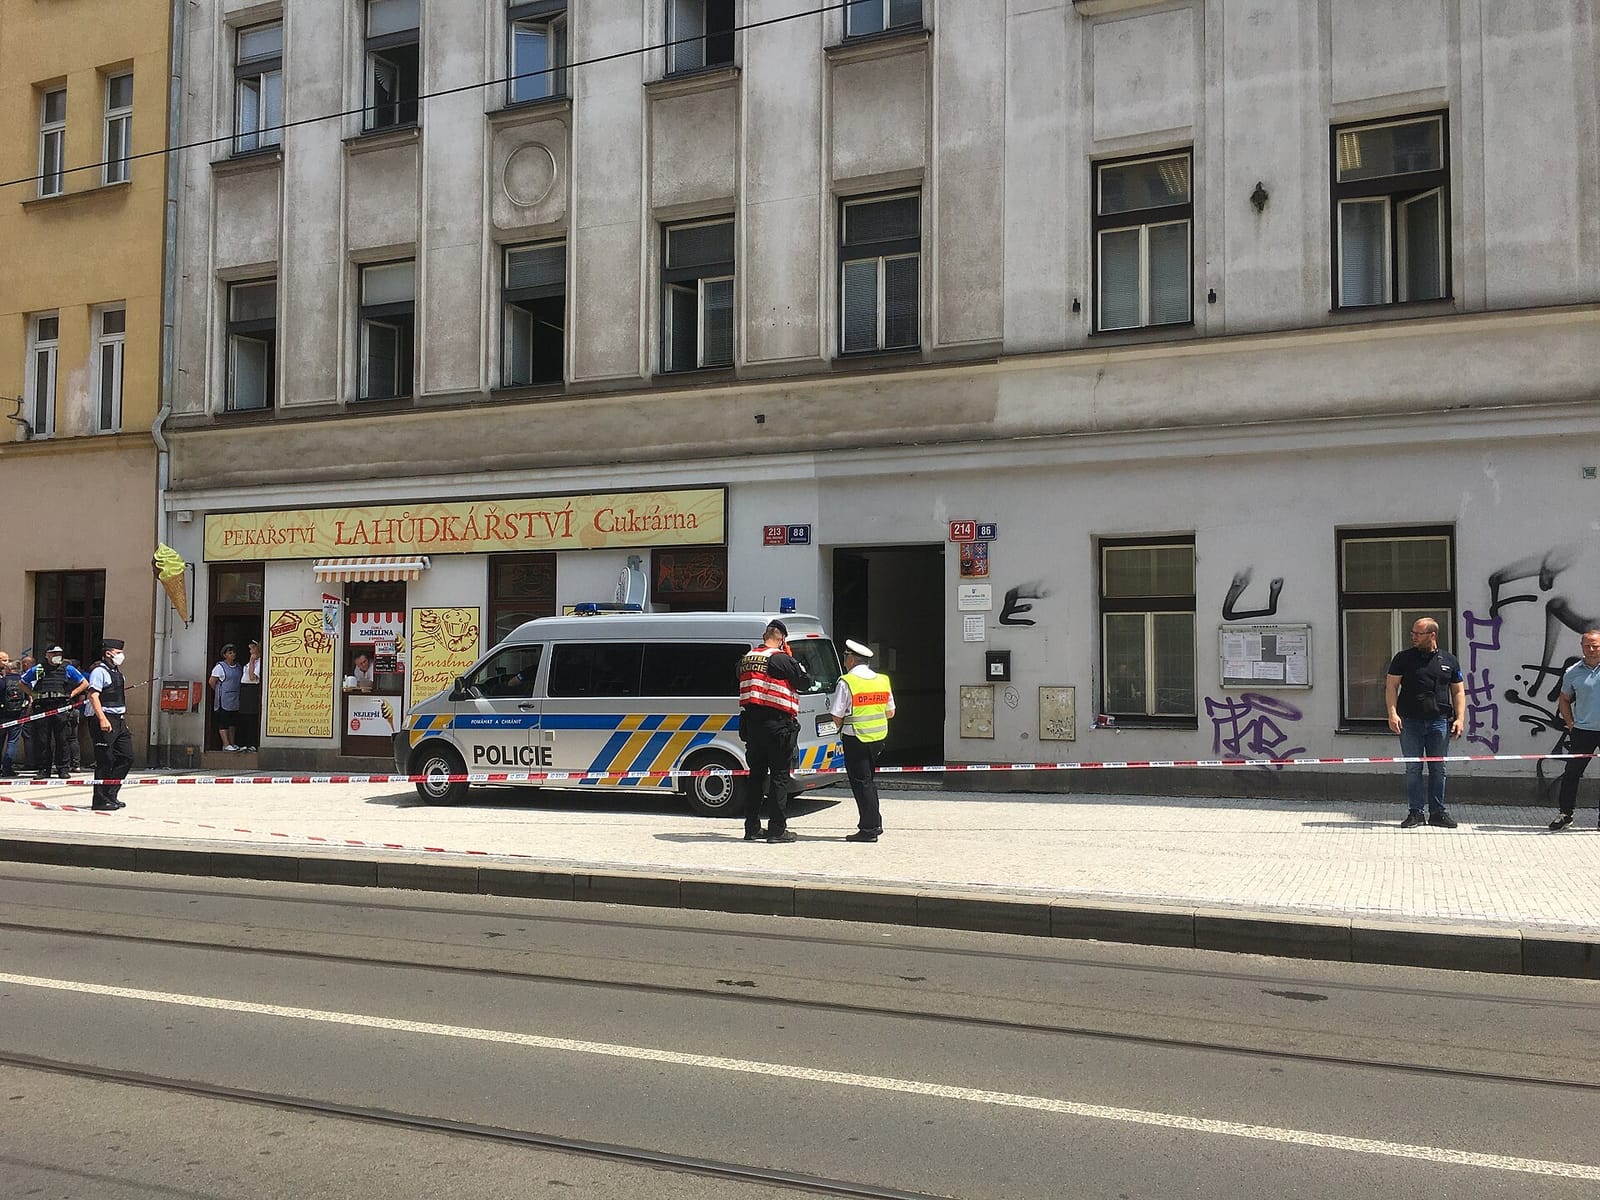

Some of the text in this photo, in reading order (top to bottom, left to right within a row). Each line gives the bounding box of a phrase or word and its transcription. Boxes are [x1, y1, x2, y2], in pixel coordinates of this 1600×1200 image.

[223, 501, 699, 546] PEKAŘSTVÍ LAHŮDKÁŘSTVÍ Cukrárna
[954, 523, 971, 535] 214
[768, 527, 781, 536] 213
[793, 528, 804, 537] 88
[981, 526, 991, 535] 86
[271, 655, 313, 668] PEČIVO
[473, 744, 553, 767] POLICIE
